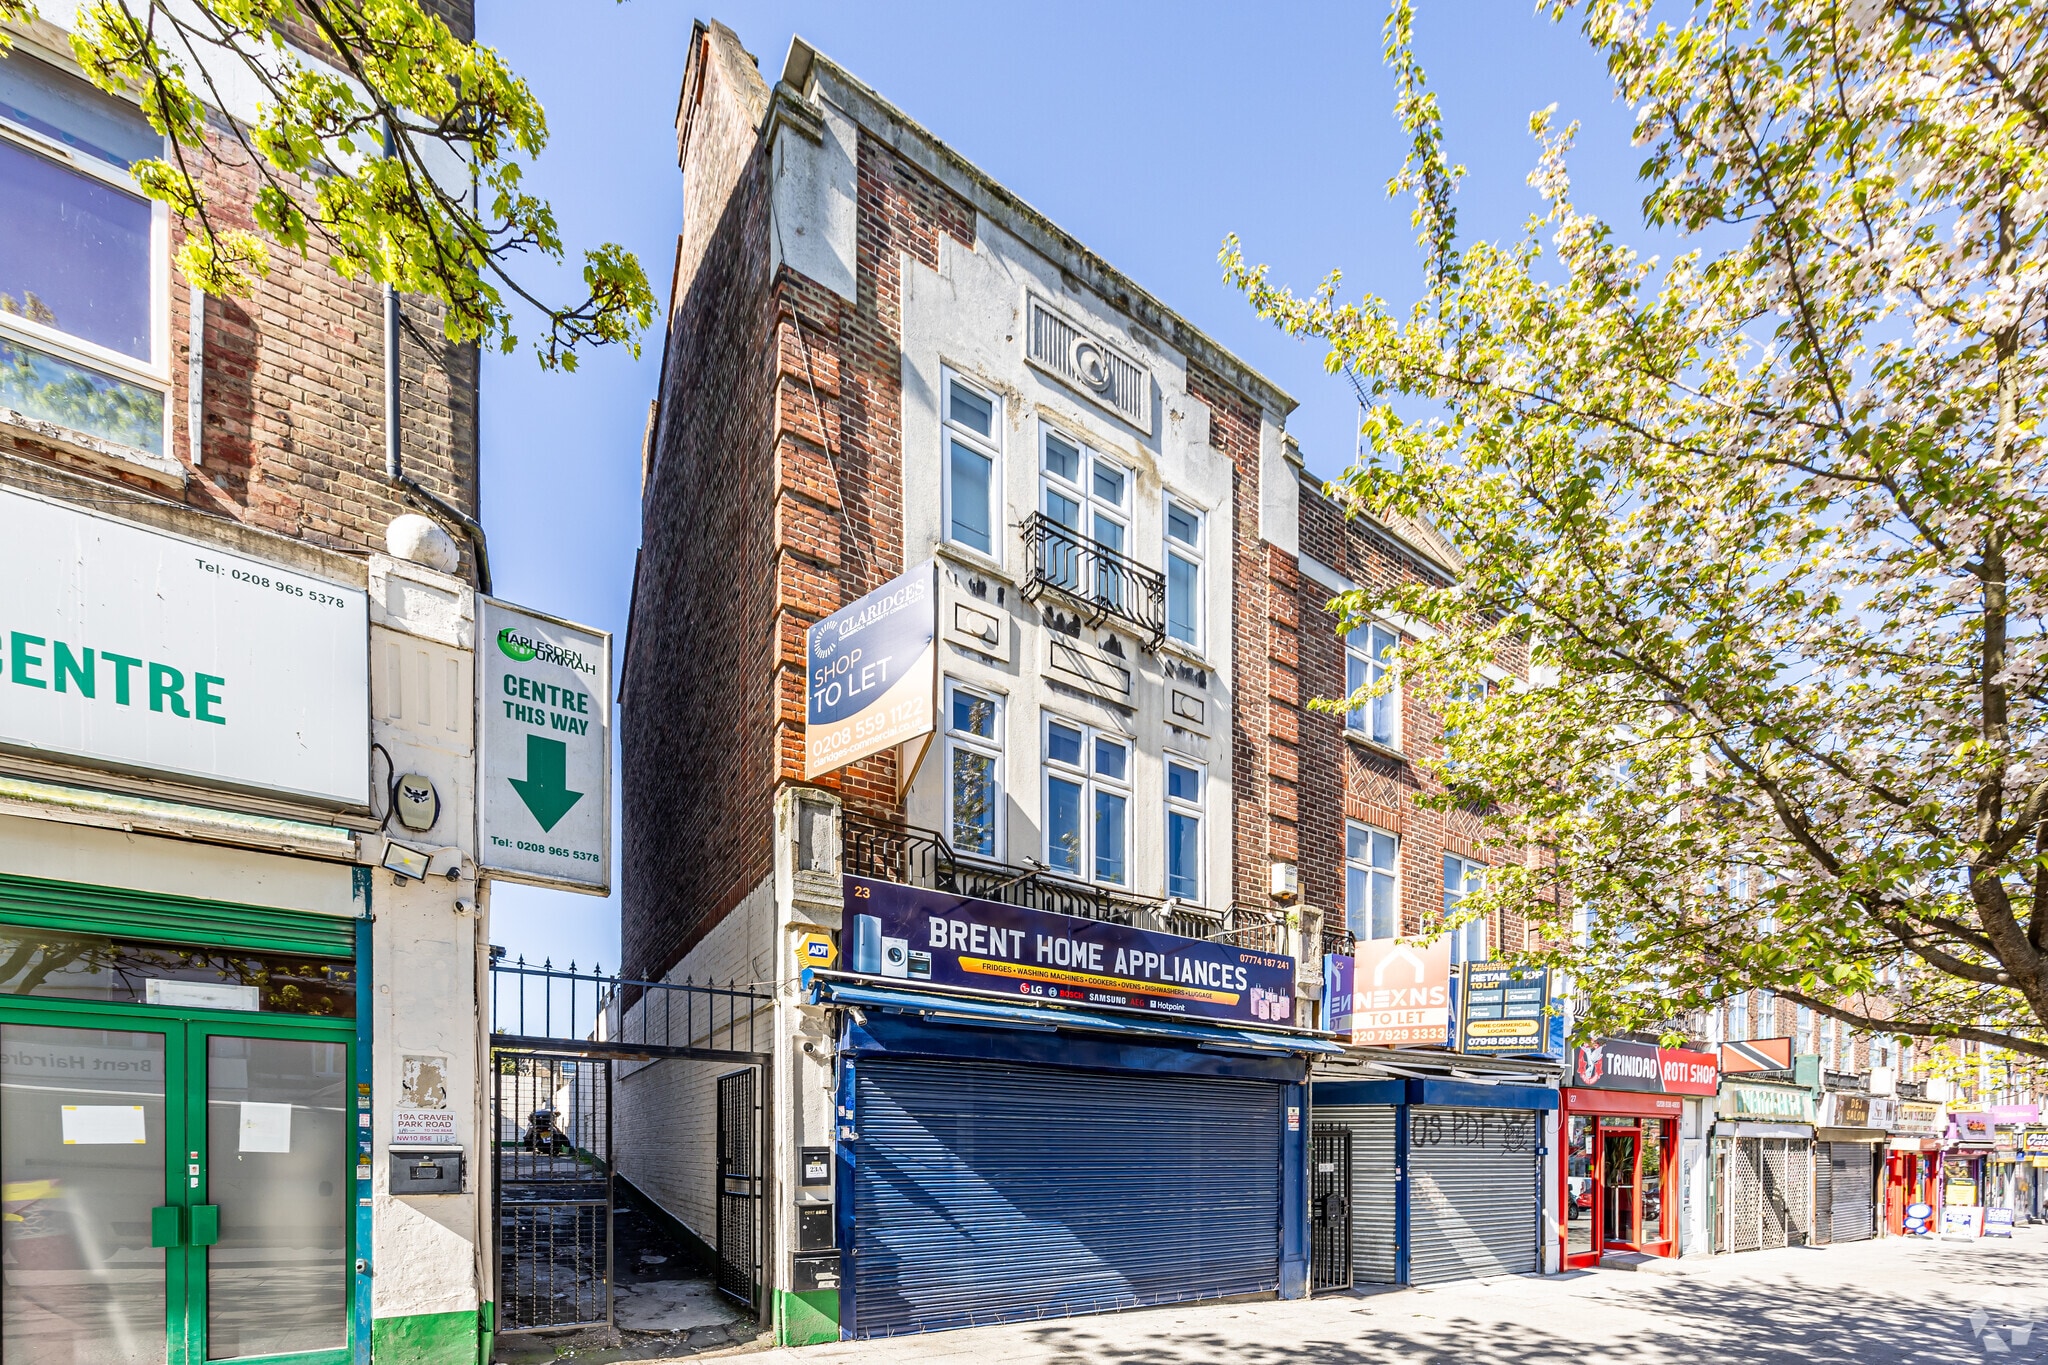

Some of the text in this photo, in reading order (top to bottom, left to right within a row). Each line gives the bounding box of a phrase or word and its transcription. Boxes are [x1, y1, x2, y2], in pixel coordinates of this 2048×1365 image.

[195, 558, 345, 609] Tel: 0208 965 5378
[838, 577, 925, 636] CLARIDGES
[866, 611, 890, 628] PROPERTY
[498, 630, 582, 662] HARLESDEN
[534, 648, 596, 676] UMMAH
[814, 648, 862, 688] SHOP
[0, 630, 226, 725] ENTRE
[813, 655, 893, 713] TO LET
[503, 673, 589, 715] CENTRE
[502, 700, 589, 736] THIS WAY
[812, 696, 924, 757] 0208 559 1122
[490, 835, 600, 863] Tel: 0208 965 5378
[854, 885, 871, 899] 23
[808, 943, 829, 957] ADT
[928, 916, 1247, 991] BRENT HOME APPLIANCES
[1239, 953, 1290, 970] 07774 187 241
[982, 962, 1213, 999] FRIDGES WASHING MACHINES COOKERS OVENS DISHWASHERS LUGGAGE
[1470, 972, 1510, 982] RETAIL
[1483, 981, 1500, 989] LET
[1031, 985, 1043, 995] LG
[1059, 989, 1084, 999] BOSCH
[1089, 993, 1127, 1005] SAMSUNG
[1353, 985, 1446, 1009] NEXNS
[1130, 997, 1145, 1007] AEG
[1157, 1000, 1186, 1012] Hotpoint
[1369, 1011, 1426, 1026] TO LET
[1353, 1027, 1446, 1042] 020 7929 3333
[1606, 1053, 1657, 1079] TRINIDAD
[1663, 1061, 1716, 1084] ROTI SHOP
[398, 1113, 416, 1121] 19A
[1846, 1110, 1866, 1121] SALON
